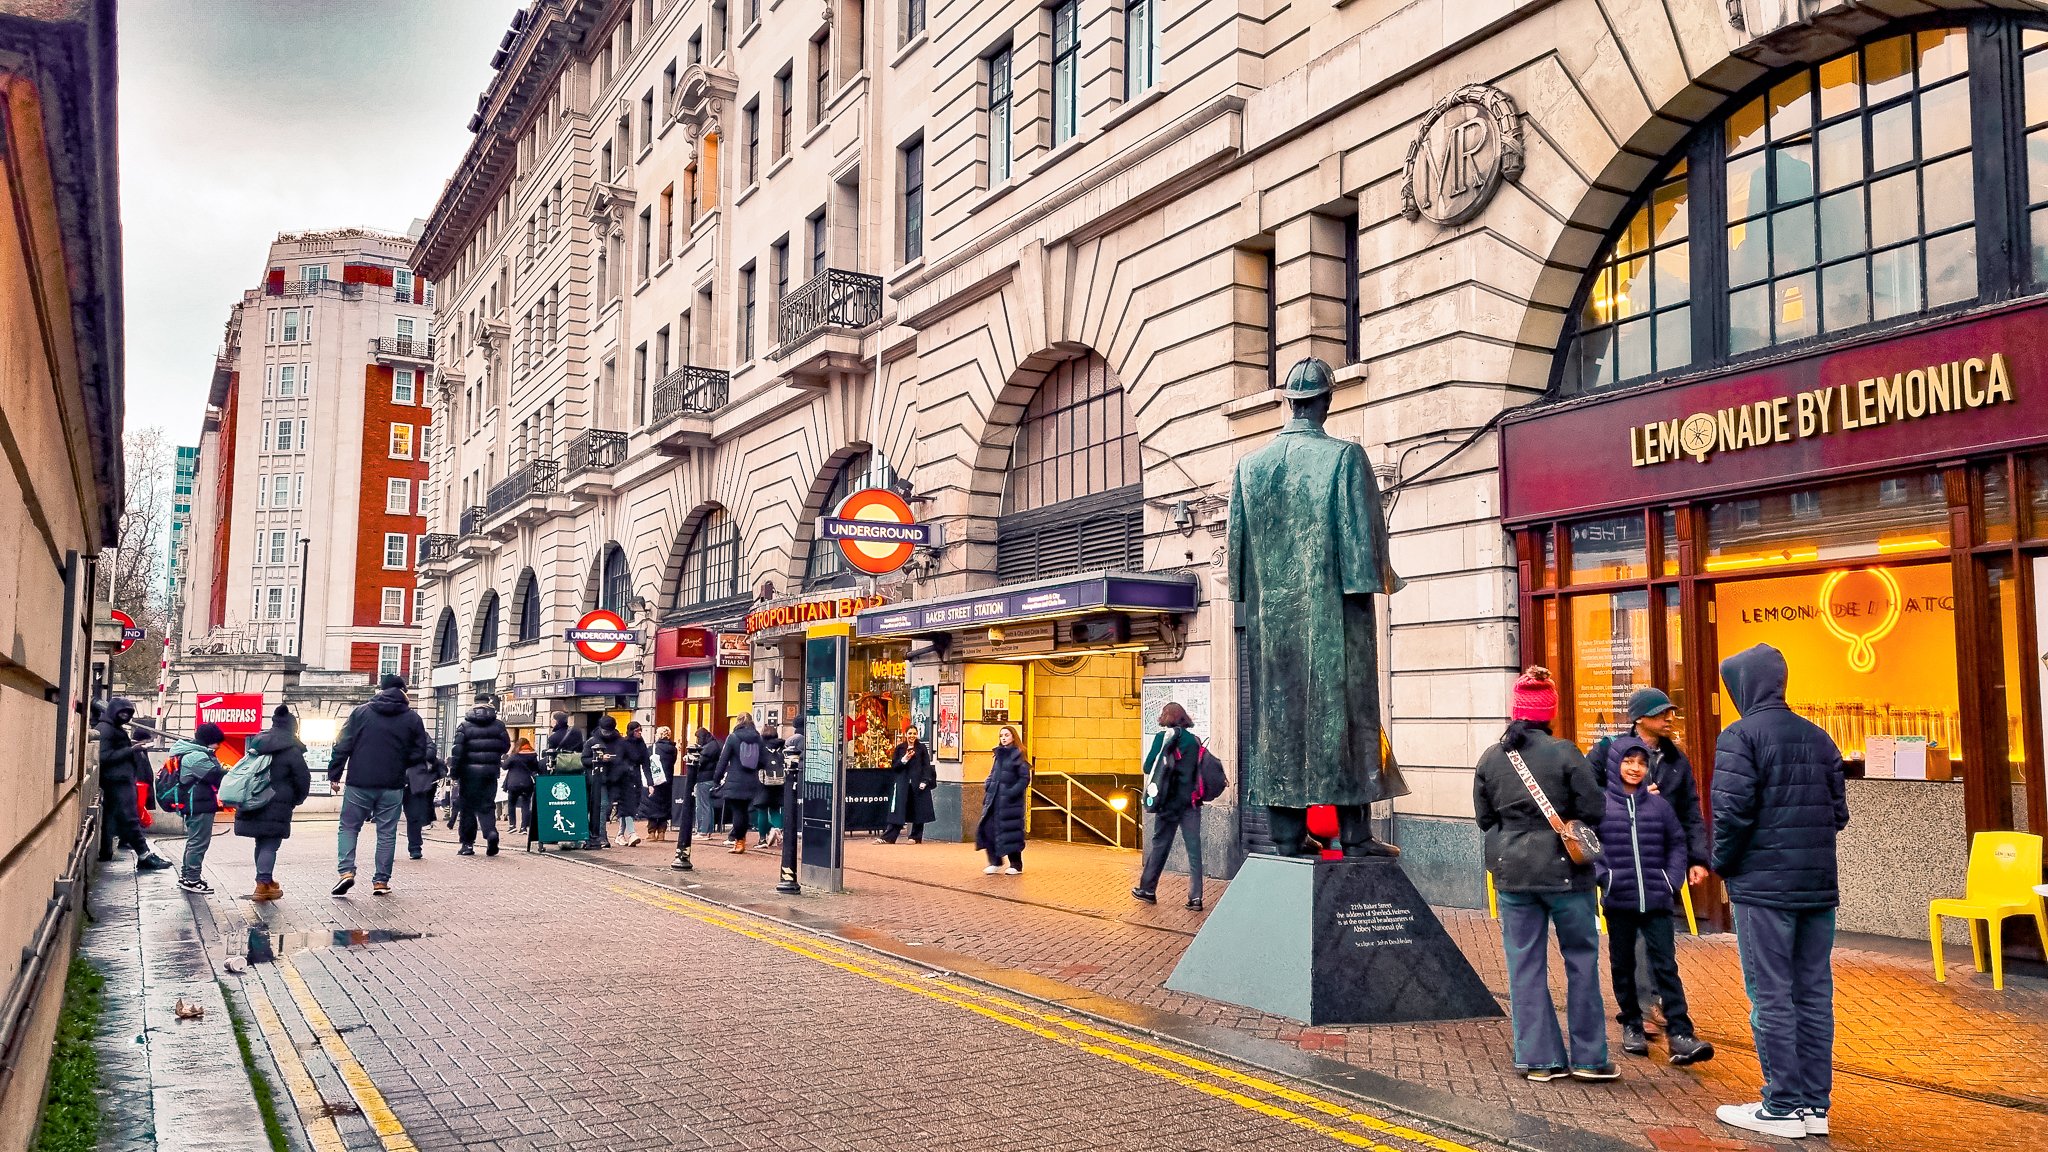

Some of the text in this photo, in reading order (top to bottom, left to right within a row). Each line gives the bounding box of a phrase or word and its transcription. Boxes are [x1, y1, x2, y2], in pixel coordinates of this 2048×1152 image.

[1630, 352, 2011, 467] LEMONADE BY LEMONICA
[829, 523, 923, 541] UNDERGROUND
[839, 595, 883, 617] BAR
[925, 610, 946, 624] BAKER
[947, 606, 971, 621] STREET
[974, 602, 1004, 617] STATION
[571, 631, 634, 642] UNDERGROUND
[990, 698, 1005, 709] LFB
[202, 708, 257, 723] WONDERPASS
[1353, 925, 1371, 933] Abbey
